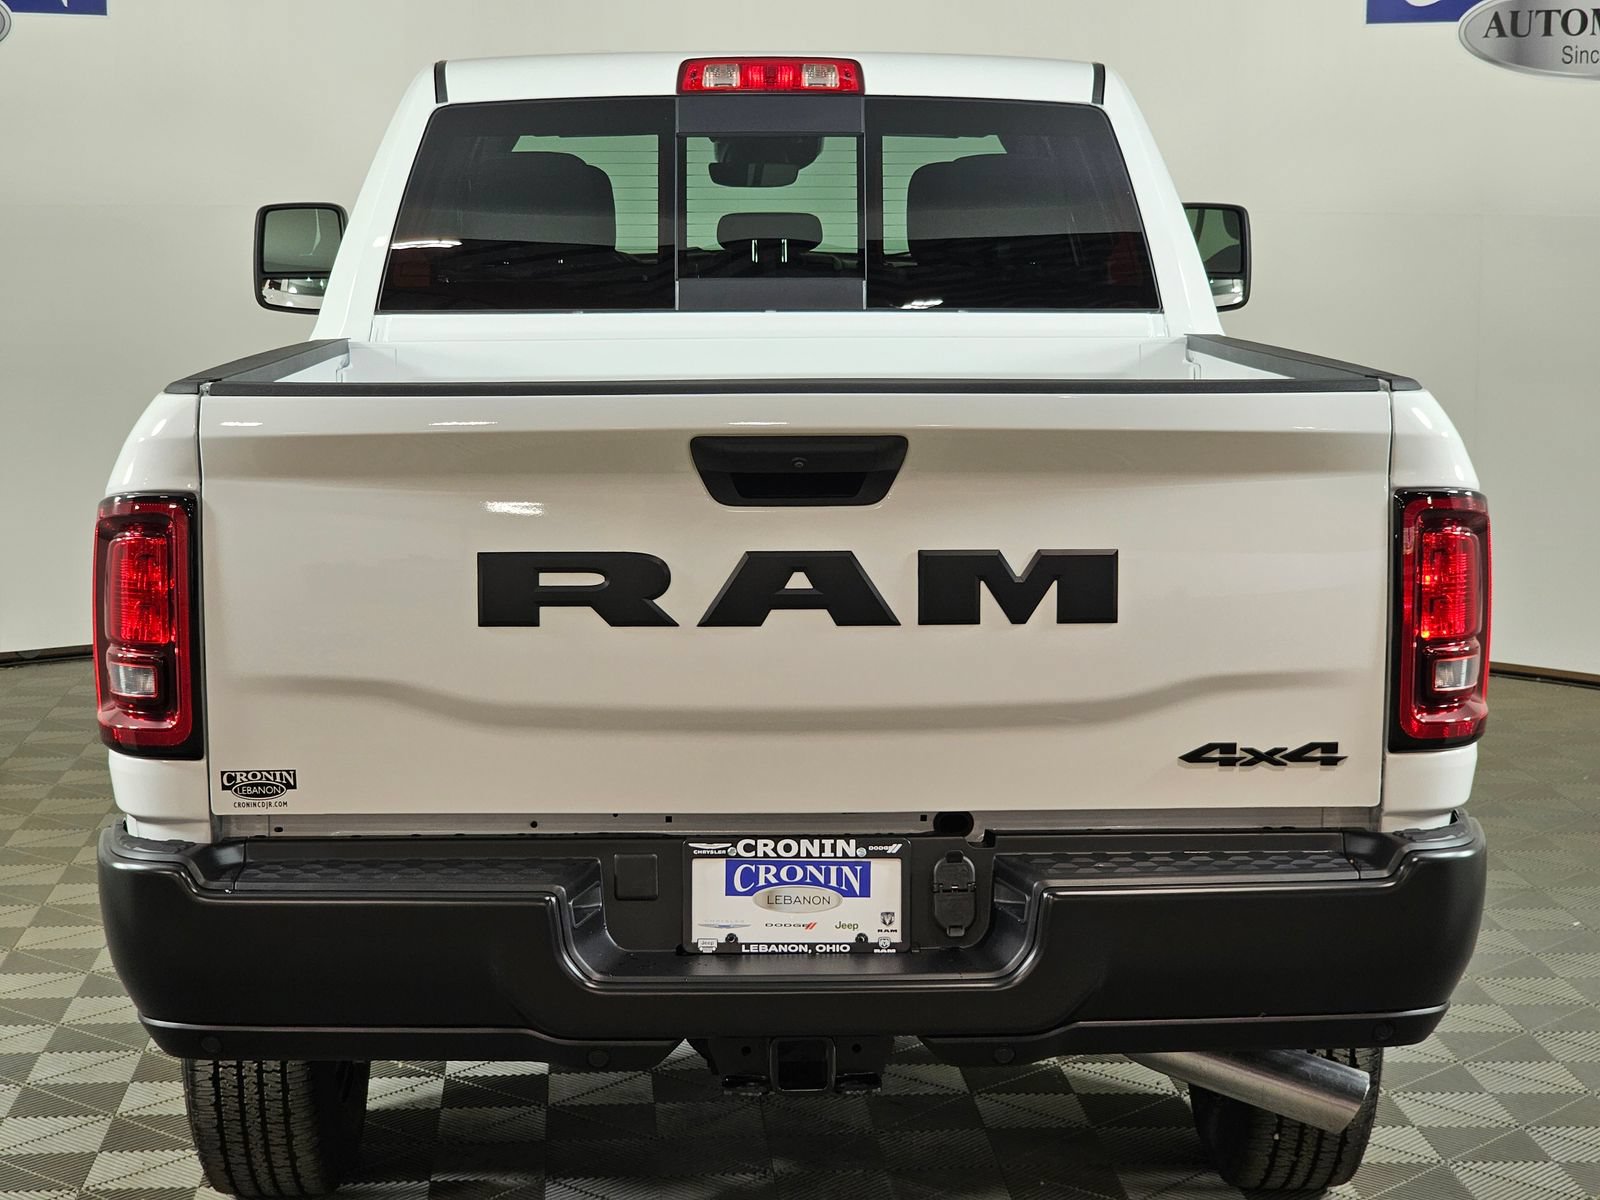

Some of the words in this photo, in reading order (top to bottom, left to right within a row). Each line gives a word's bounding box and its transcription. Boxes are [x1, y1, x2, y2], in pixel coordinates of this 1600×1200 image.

[1483, 8, 1600, 38] AUTO
[1561, 45, 1600, 65] Sinc
[477, 549, 1118, 627] RAM
[1178, 742, 1348, 767] 4x4
[222, 771, 294, 786] CRONIN
[237, 786, 281, 795] LEBANON
[233, 801, 288, 809] CRONINCDJR.COM
[736, 838, 856, 858] CRONIN
[733, 864, 864, 896] CRONIN
[767, 895, 831, 905] LEBANON
[835, 921, 859, 931] Jeep
[741, 944, 812, 954] LEBANON,
[815, 943, 851, 953] OHIO
